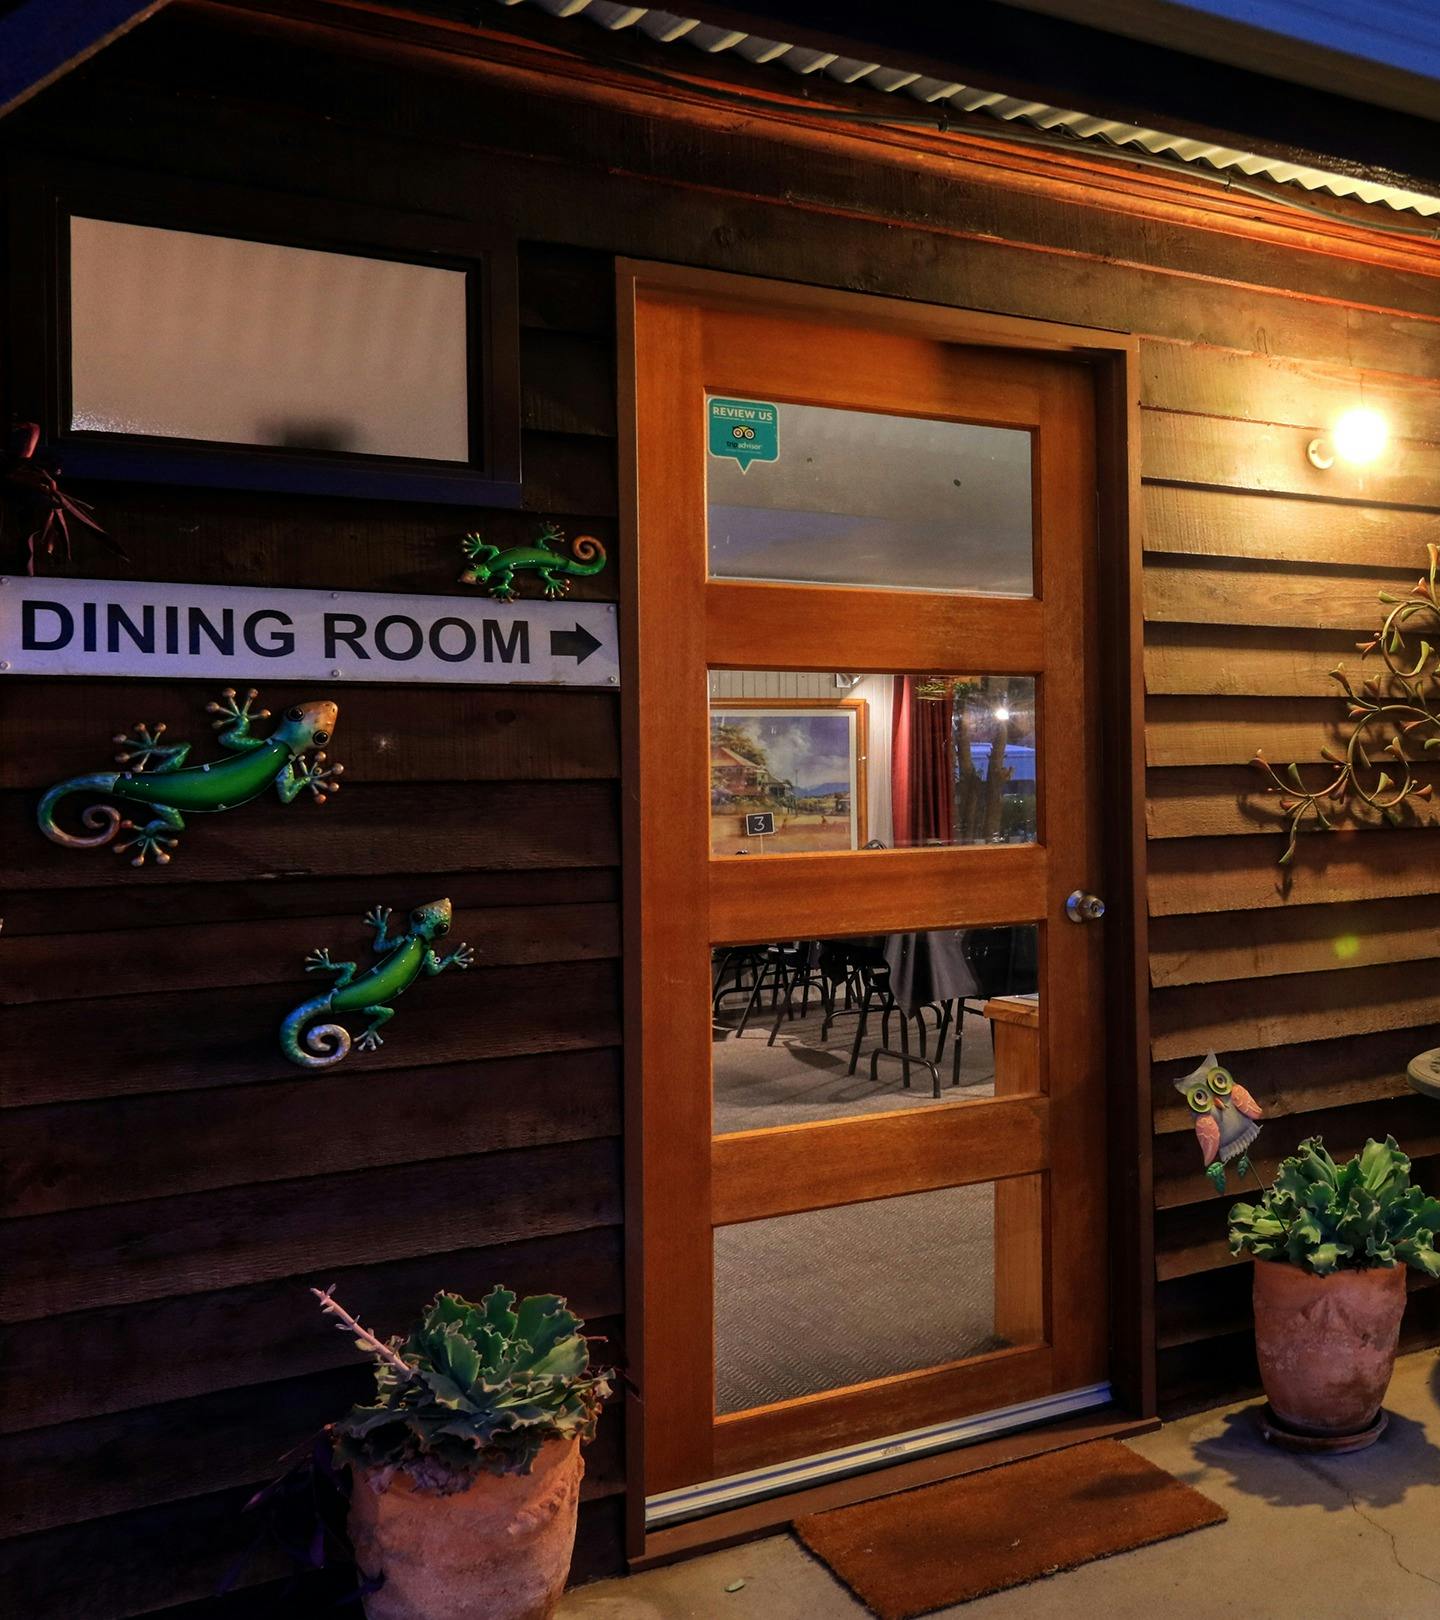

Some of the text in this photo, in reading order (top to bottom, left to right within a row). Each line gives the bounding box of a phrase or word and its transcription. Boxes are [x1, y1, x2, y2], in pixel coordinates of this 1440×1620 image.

[713, 406, 773, 421] REVIEW US
[21, 599, 530, 664] DINING ROOM
[754, 816, 765, 831] 3
